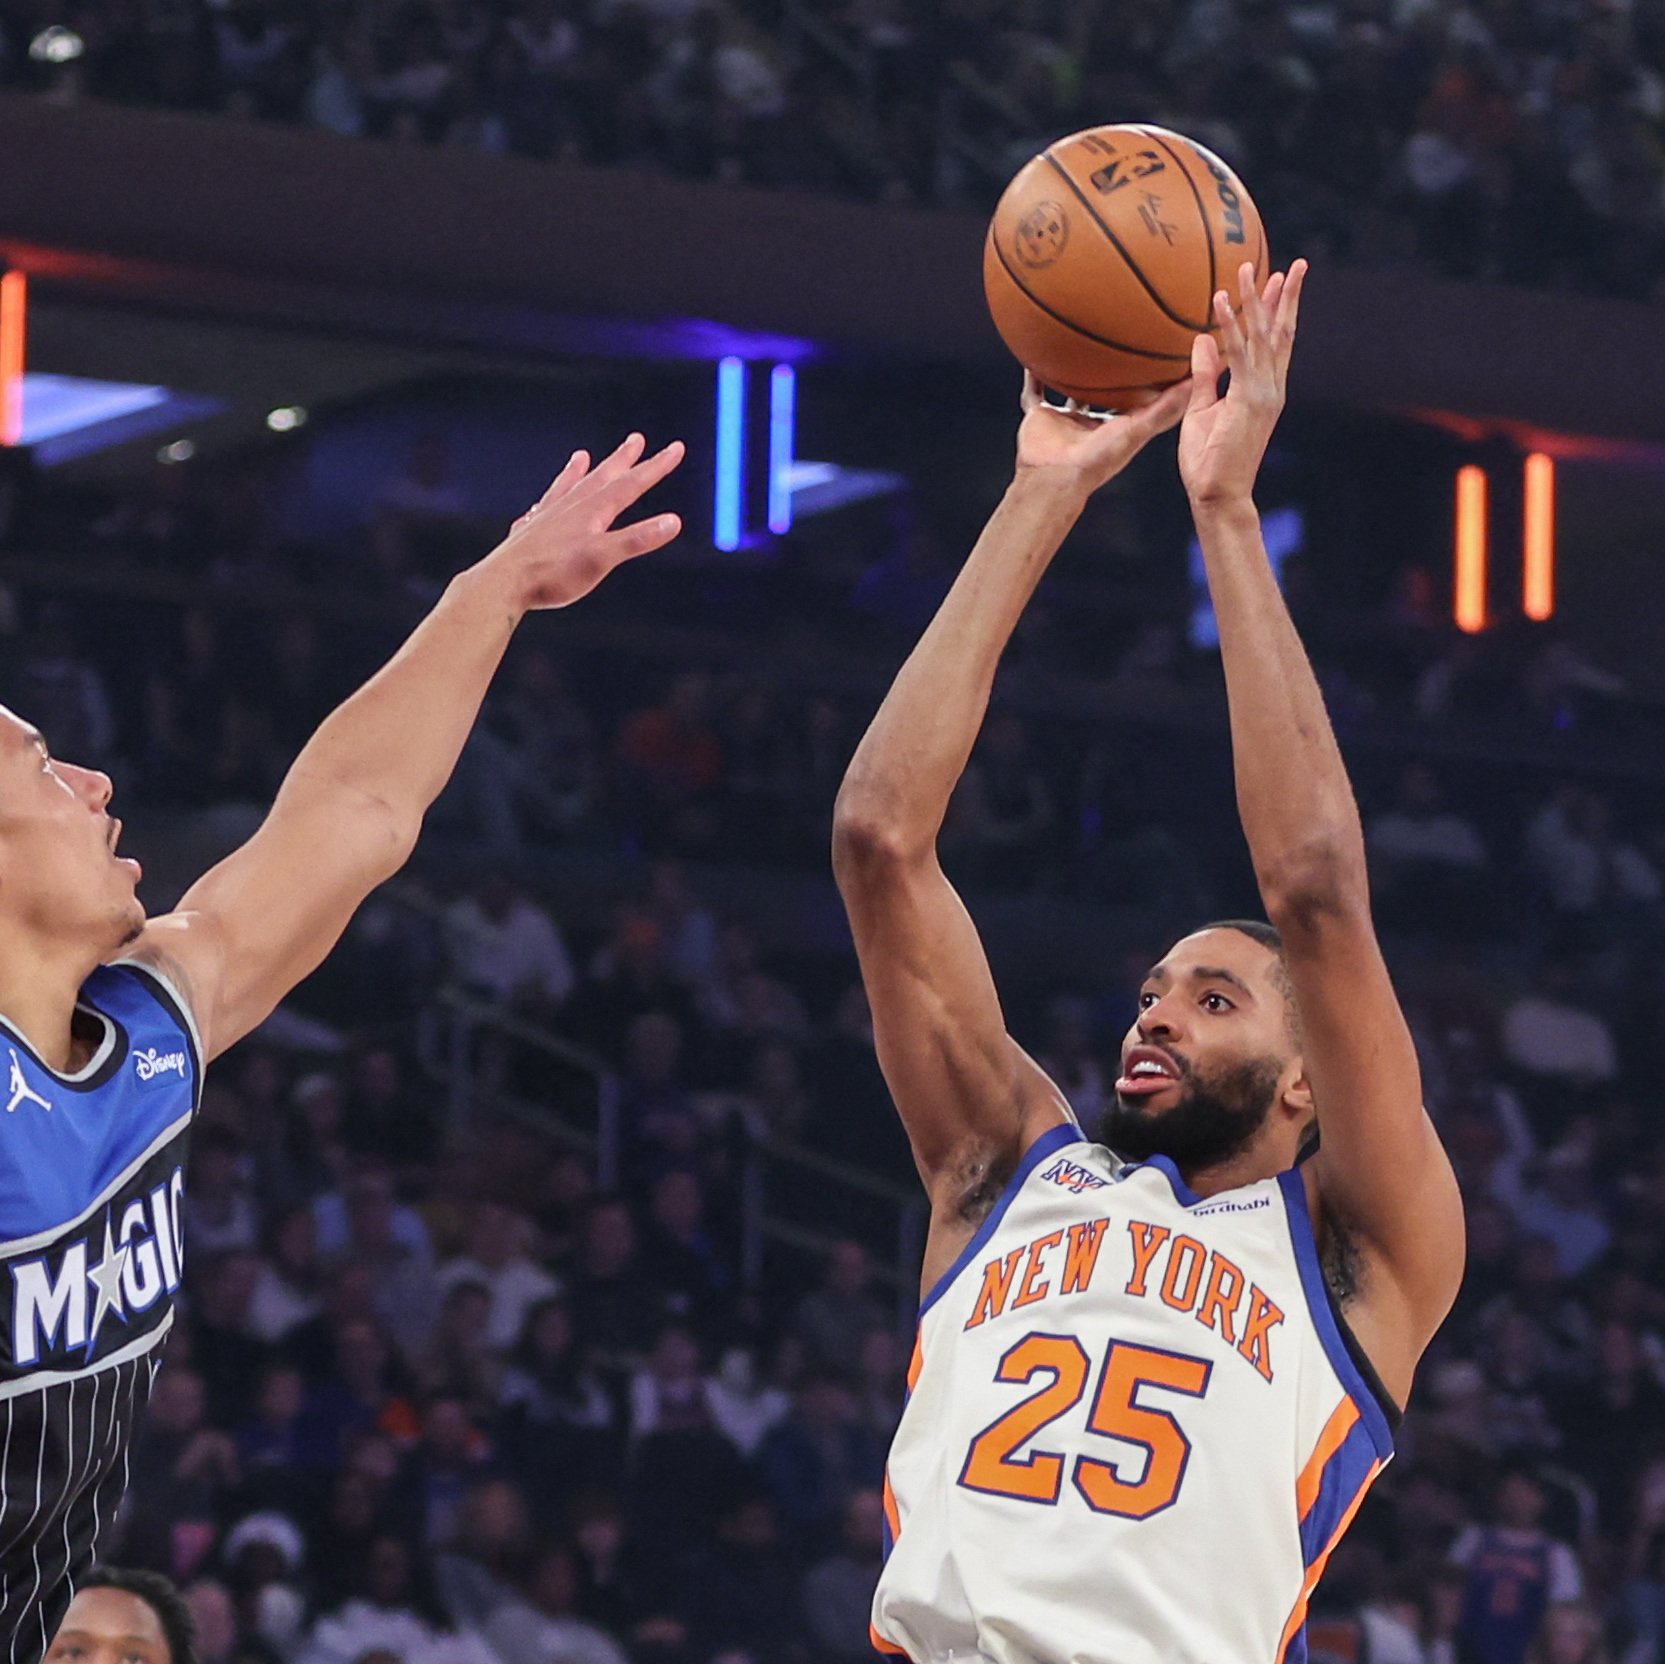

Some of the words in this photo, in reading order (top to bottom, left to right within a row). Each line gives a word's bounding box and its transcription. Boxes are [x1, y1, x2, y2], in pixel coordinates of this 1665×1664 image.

[132, 1047, 186, 1081] Disney
[963, 1217, 1110, 1332] NEW
[1124, 1219, 1285, 1385] YORK
[956, 1331, 1214, 1521] 25
